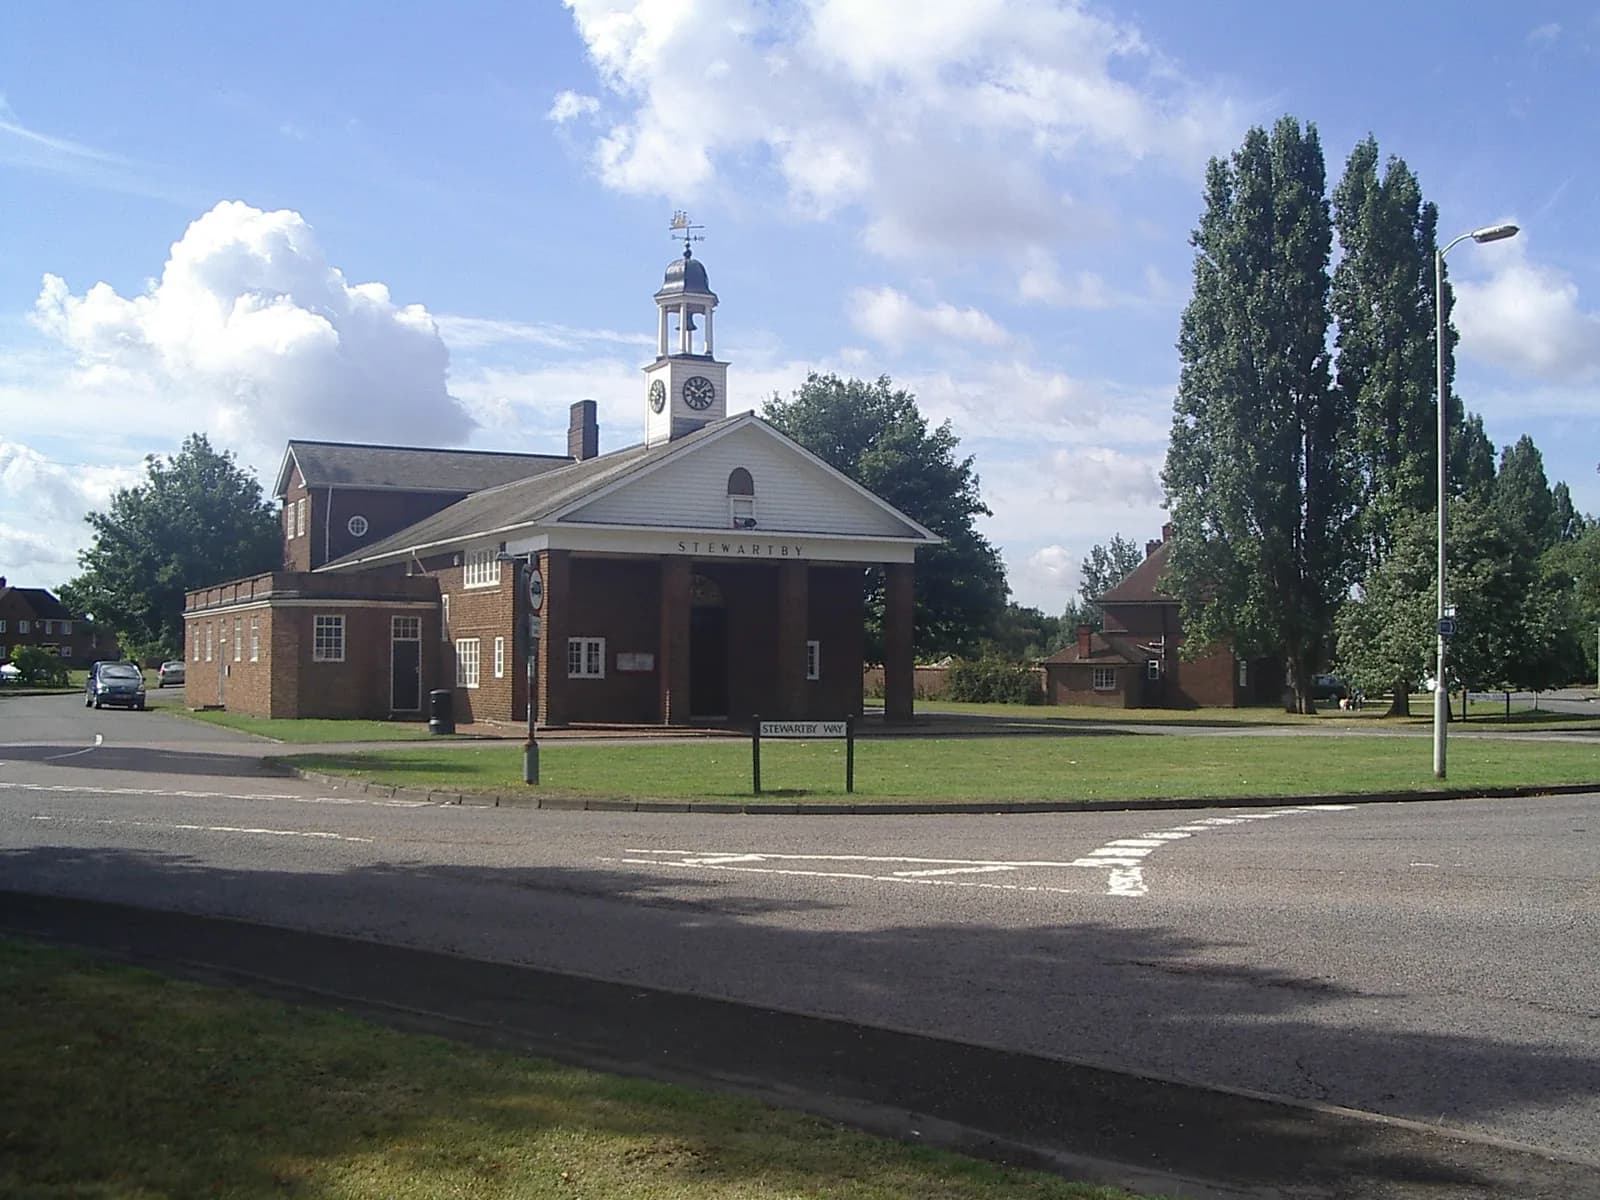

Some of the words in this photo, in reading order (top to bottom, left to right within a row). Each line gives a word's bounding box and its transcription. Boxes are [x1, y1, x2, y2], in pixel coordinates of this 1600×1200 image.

[678, 541, 803, 556] STEWARTBY
[762, 724, 818, 734] STEWARTBY
[823, 724, 844, 734] WAY
